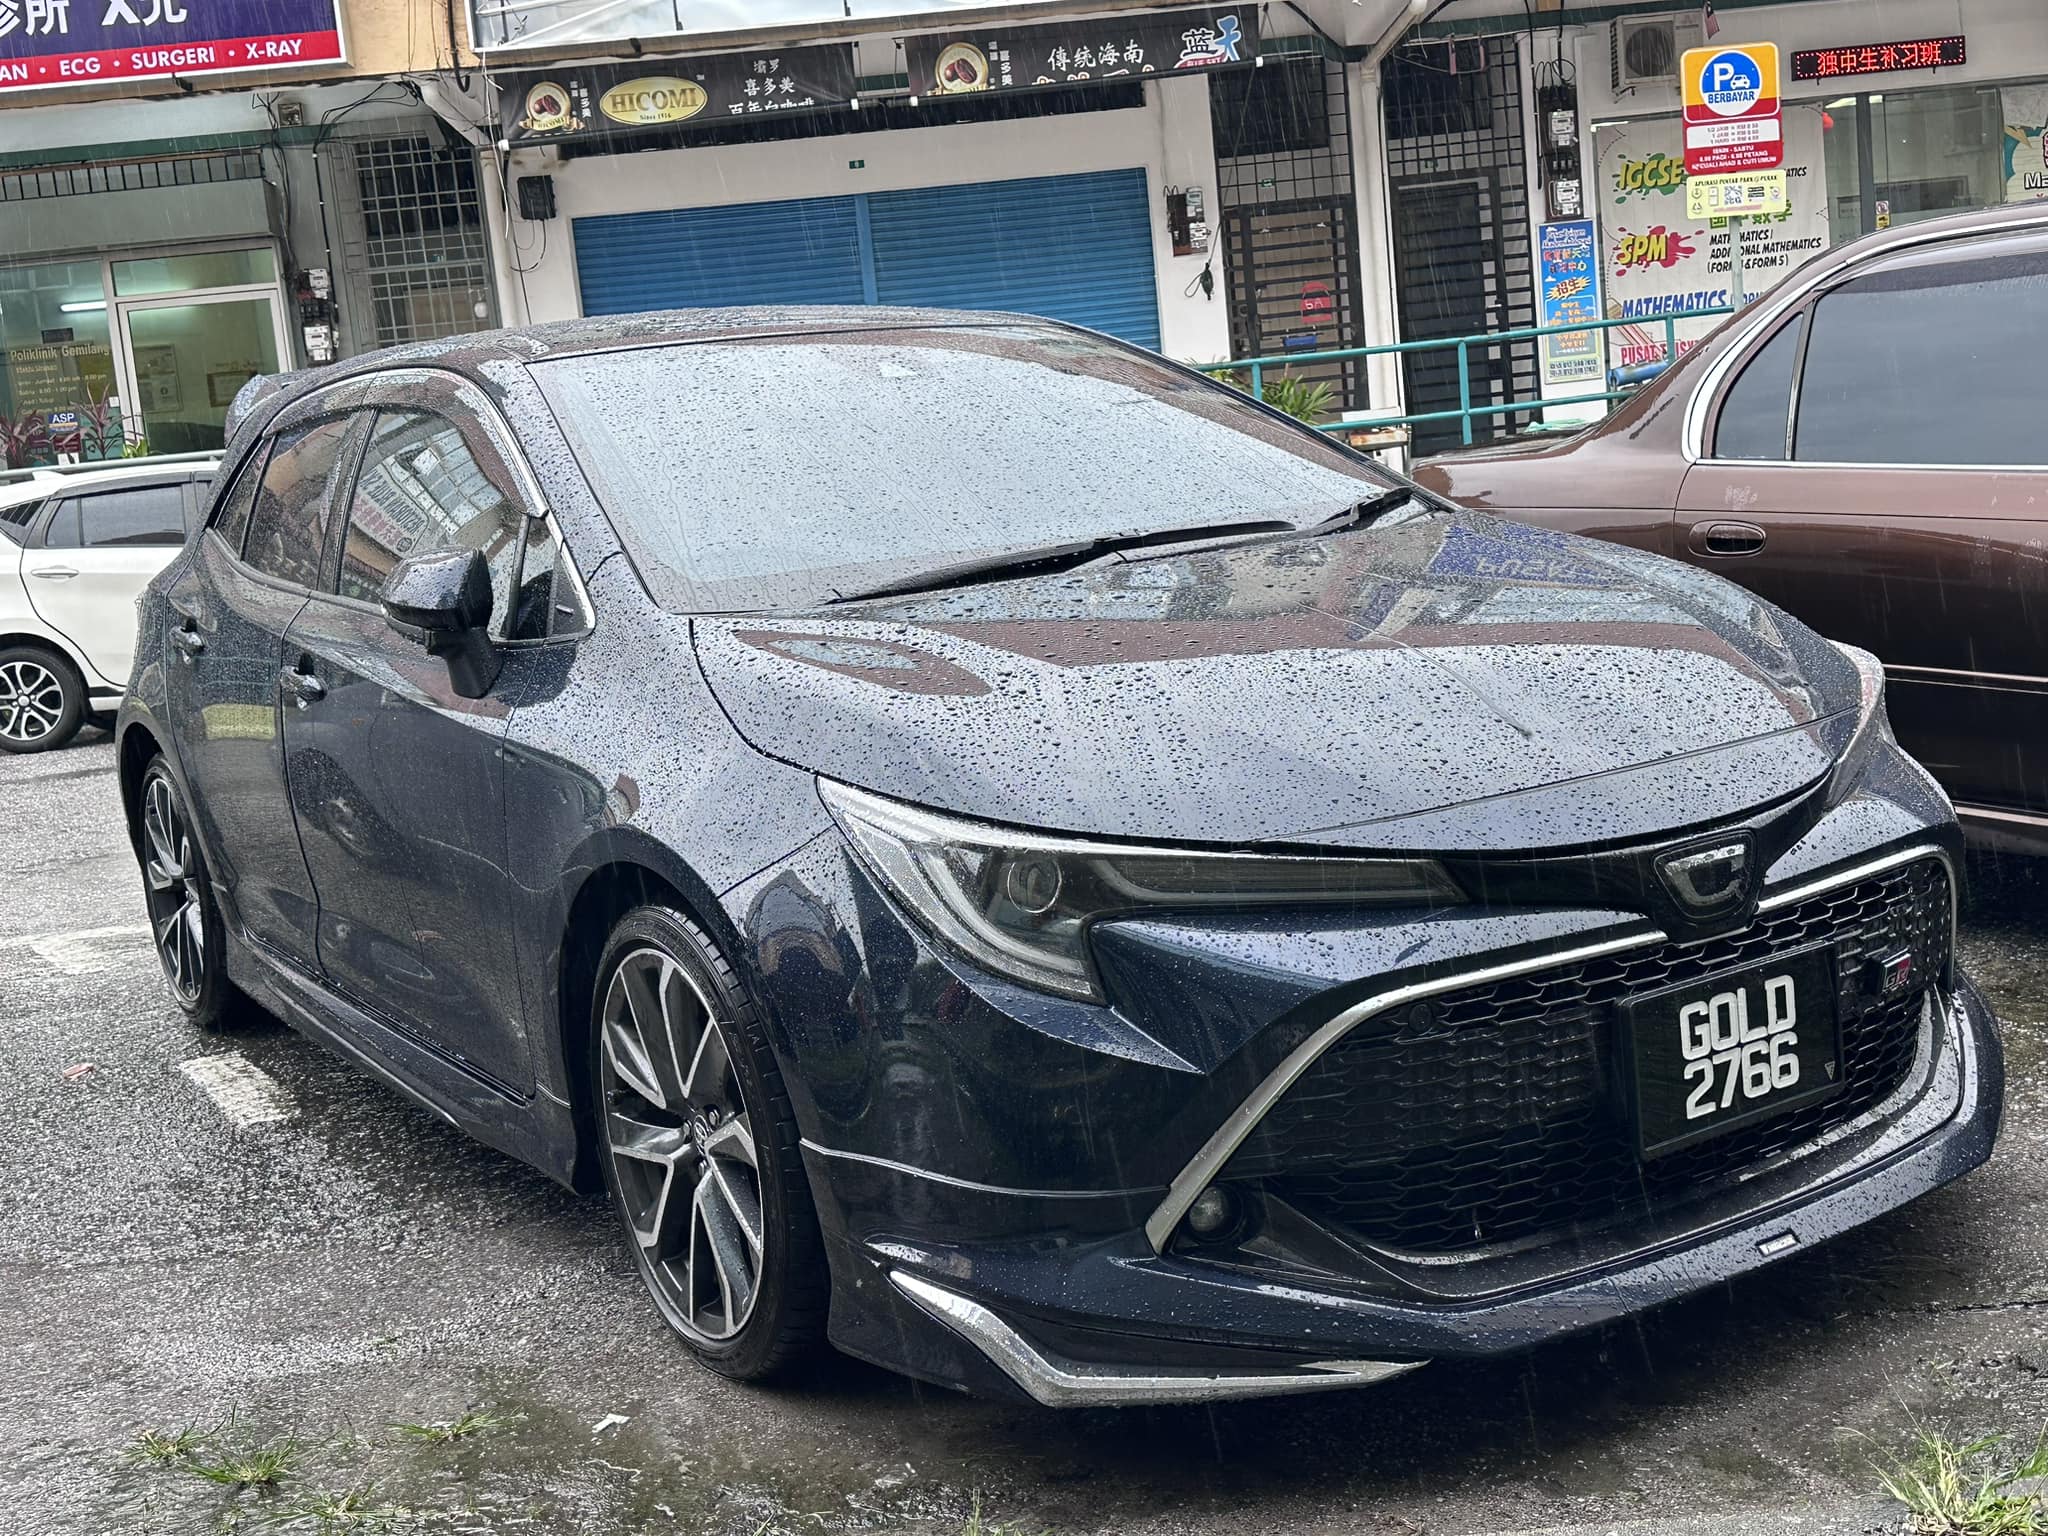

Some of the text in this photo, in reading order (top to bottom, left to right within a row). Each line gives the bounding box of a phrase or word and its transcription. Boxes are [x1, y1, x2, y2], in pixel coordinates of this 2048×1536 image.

[59, 57, 101, 77] ECG
[131, 47, 215, 70] SURGERI
[245, 39, 302, 59] X-RAY
[1047, 39, 1144, 72] 傳統海南
[1817, 42, 1942, 75] 独中生补习班
[609, 87, 698, 113] HICOMI
[1708, 90, 1755, 105] BERBAYAR
[1744, 150, 1768, 158] PETANG
[1618, 156, 1685, 190] IGCSE
[1618, 233, 1668, 266] SPM
[1710, 237, 1822, 260] ADDIONAL MATHEMATICS
[1556, 277, 1581, 297] 招生
[1622, 289, 1727, 318] MATHEMATICS
[10, 343, 110, 361] Poliklinik Gemilang
[52, 412, 75, 424] ASP
[1680, 974, 1797, 1061] GOLD
[1683, 1030, 1800, 1120] 2766
